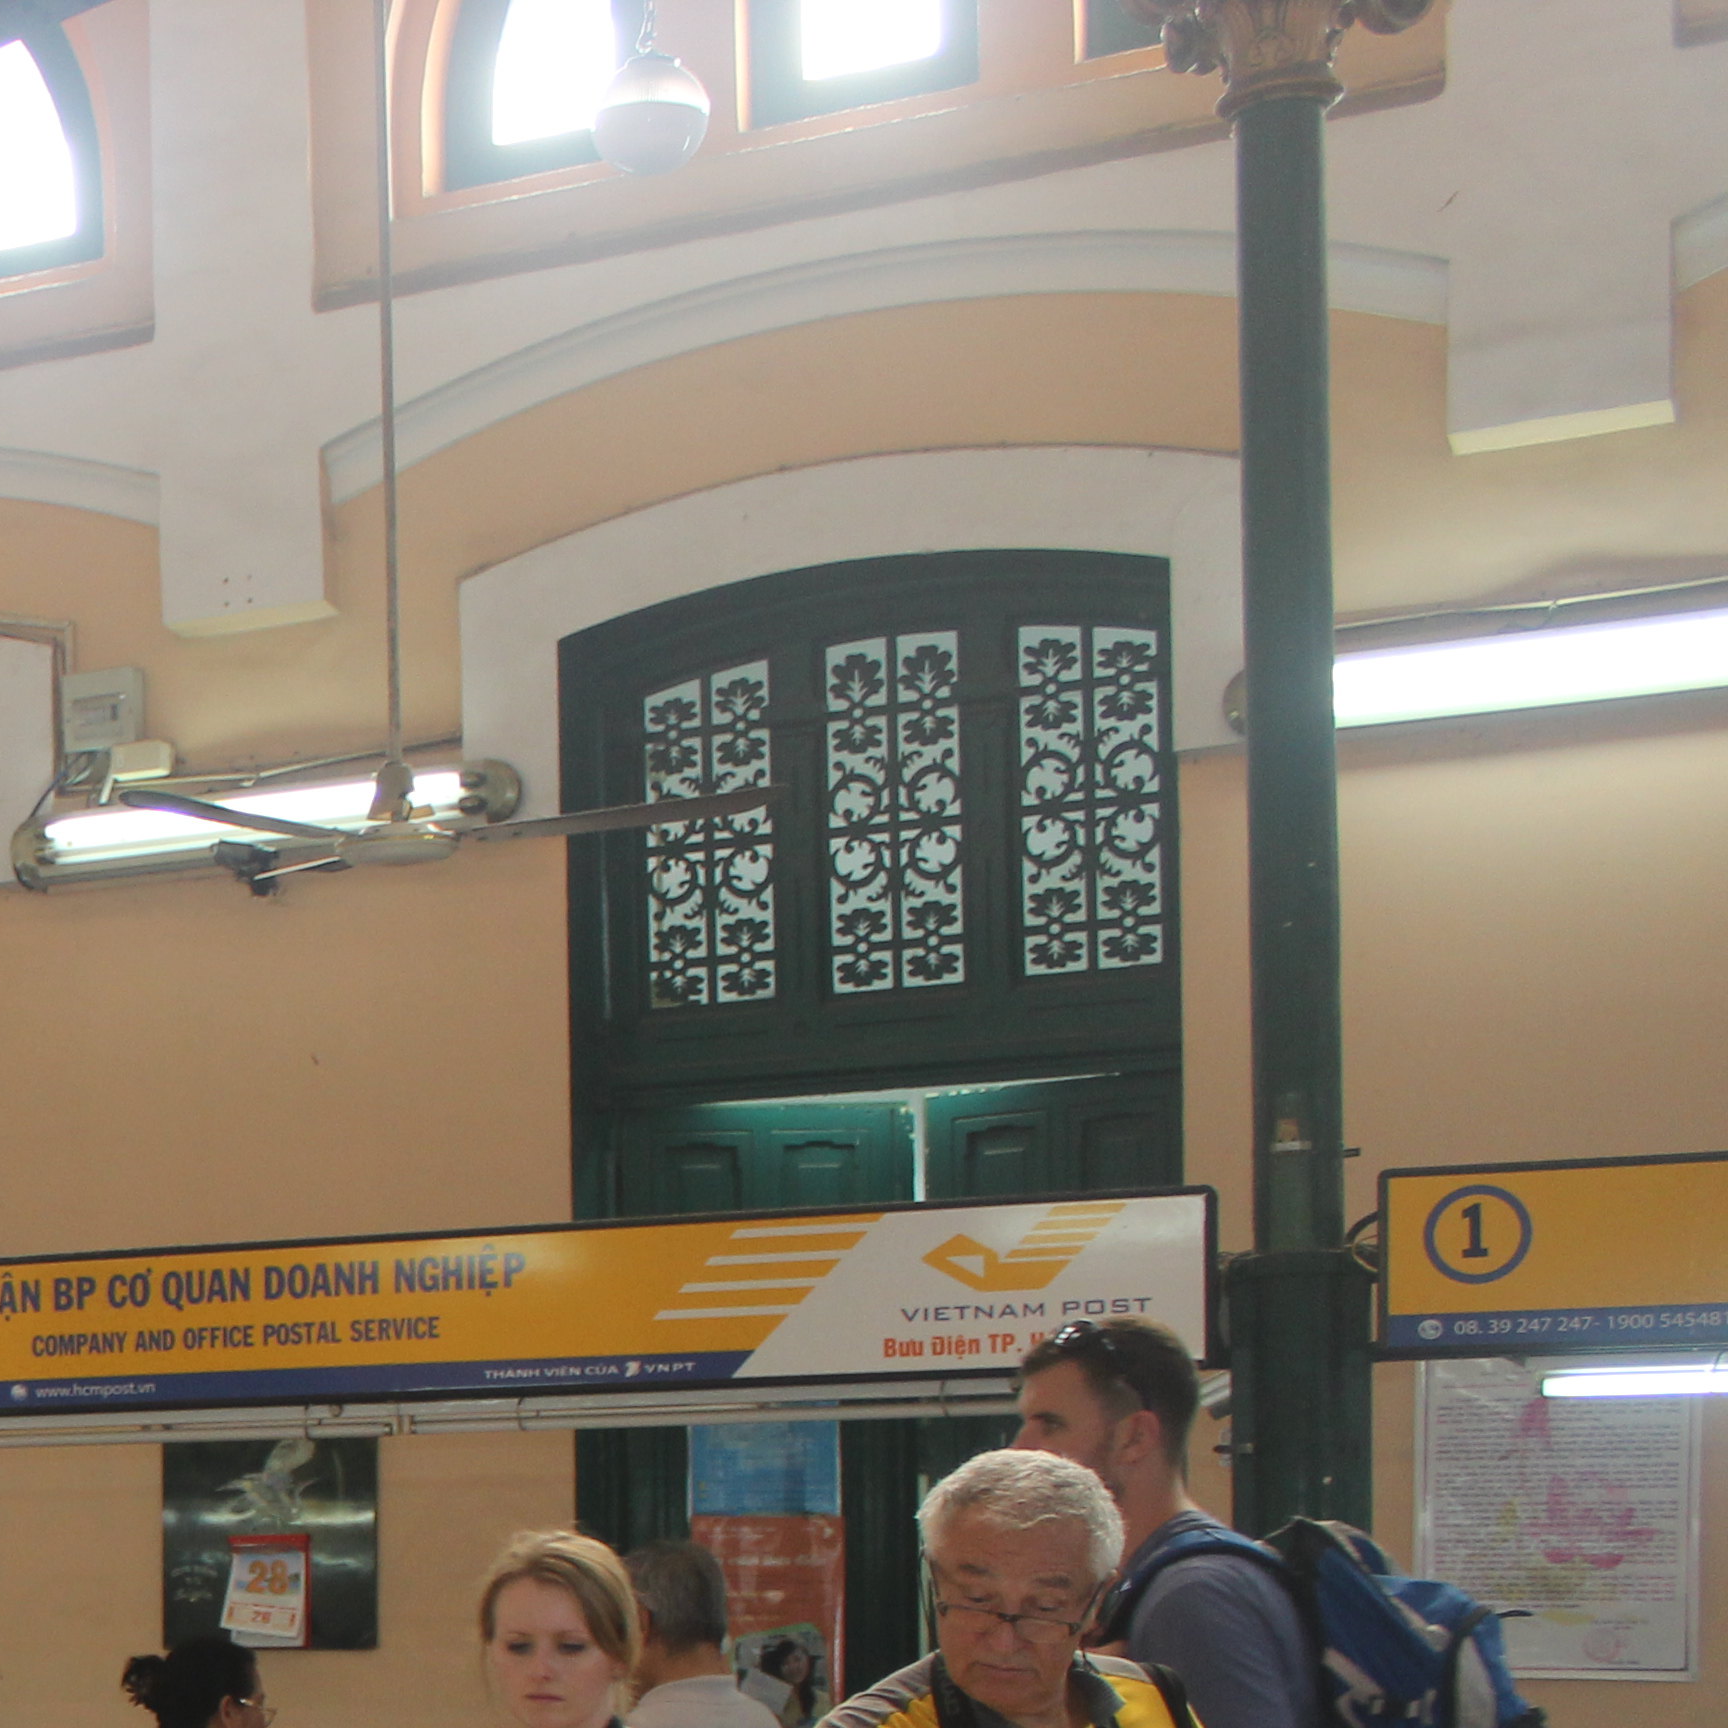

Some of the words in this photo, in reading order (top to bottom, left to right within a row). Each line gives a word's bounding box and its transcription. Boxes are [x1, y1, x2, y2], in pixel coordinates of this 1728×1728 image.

[1462, 1202, 1488, 1258] 1
[54, 1276, 96, 1311] BP
[108, 1268, 153, 1309] CƠ
[162, 1267, 251, 1311] QUAN
[264, 1260, 380, 1300] DOANH
[395, 1244, 526, 1297] NGHIỆP
[901, 1302, 1044, 1322] VIETNAM
[1062, 1298, 1152, 1316] POST
[1454, 1320, 1483, 1335] 08.
[1489, 1319, 1512, 1334] 39
[1516, 1317, 1552, 1333] 247
[1608, 1314, 1654, 1330] 1900
[32, 1331, 127, 1357] COMPANY
[135, 1329, 175, 1351] AND
[183, 1325, 254, 1350] OFFICE
[263, 1321, 342, 1346] POSTAL
[350, 1317, 440, 1342] SERVICE
[883, 1337, 923, 1358] Bưu
[931, 1335, 980, 1359] Điện
[644, 1362, 696, 1373] VNPT
[34, 1381, 156, 1399] www.hcmpost.vn
[245, 1560, 289, 1595] 28
